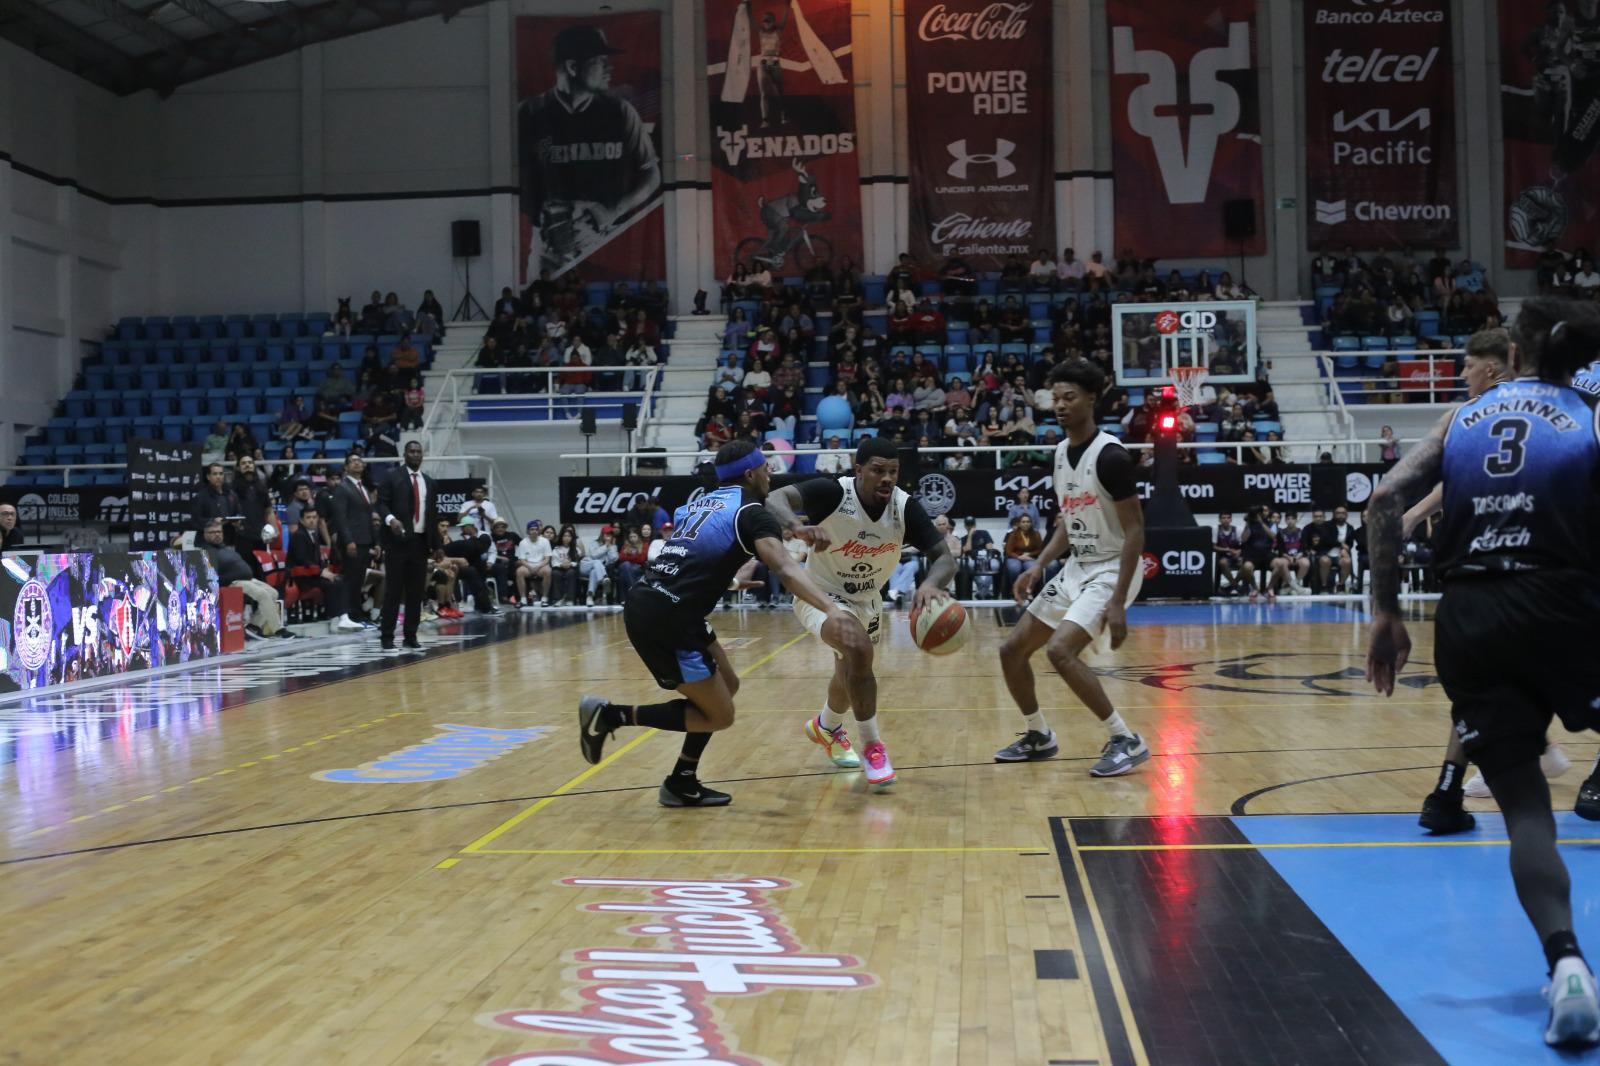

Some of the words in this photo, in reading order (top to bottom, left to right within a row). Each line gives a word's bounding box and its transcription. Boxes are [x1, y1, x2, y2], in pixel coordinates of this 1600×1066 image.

[918, 2, 1032, 41] Coca-Cola
[1315, 10, 1374, 25] Banco
[1378, 9, 1444, 24] Azteca
[1321, 46, 1440, 84] telcel
[927, 70, 1027, 94] POWER
[973, 92, 1028, 116] ADE
[1333, 140, 1432, 165] Pacific
[935, 186, 975, 194] UNDER
[978, 184, 1029, 193] ARMOUR
[1354, 201, 1451, 221] Chevron
[931, 212, 1032, 245] Caliente
[958, 243, 1030, 255] caliente.mx
[1180, 312, 1217, 329] CID
[1461, 399, 1581, 433] MCKINNEY
[1484, 416, 1532, 478] 3
[1135, 481, 1215, 499] Chron
[1243, 473, 1311, 489] POWER
[48, 493, 80, 504] COLEGIO
[994, 494, 1054, 511] Pafic
[1274, 488, 1312, 504] ADE
[671, 509, 715, 541] 11
[1161, 550, 1206, 570] CID
[71, 604, 98, 646] VS
